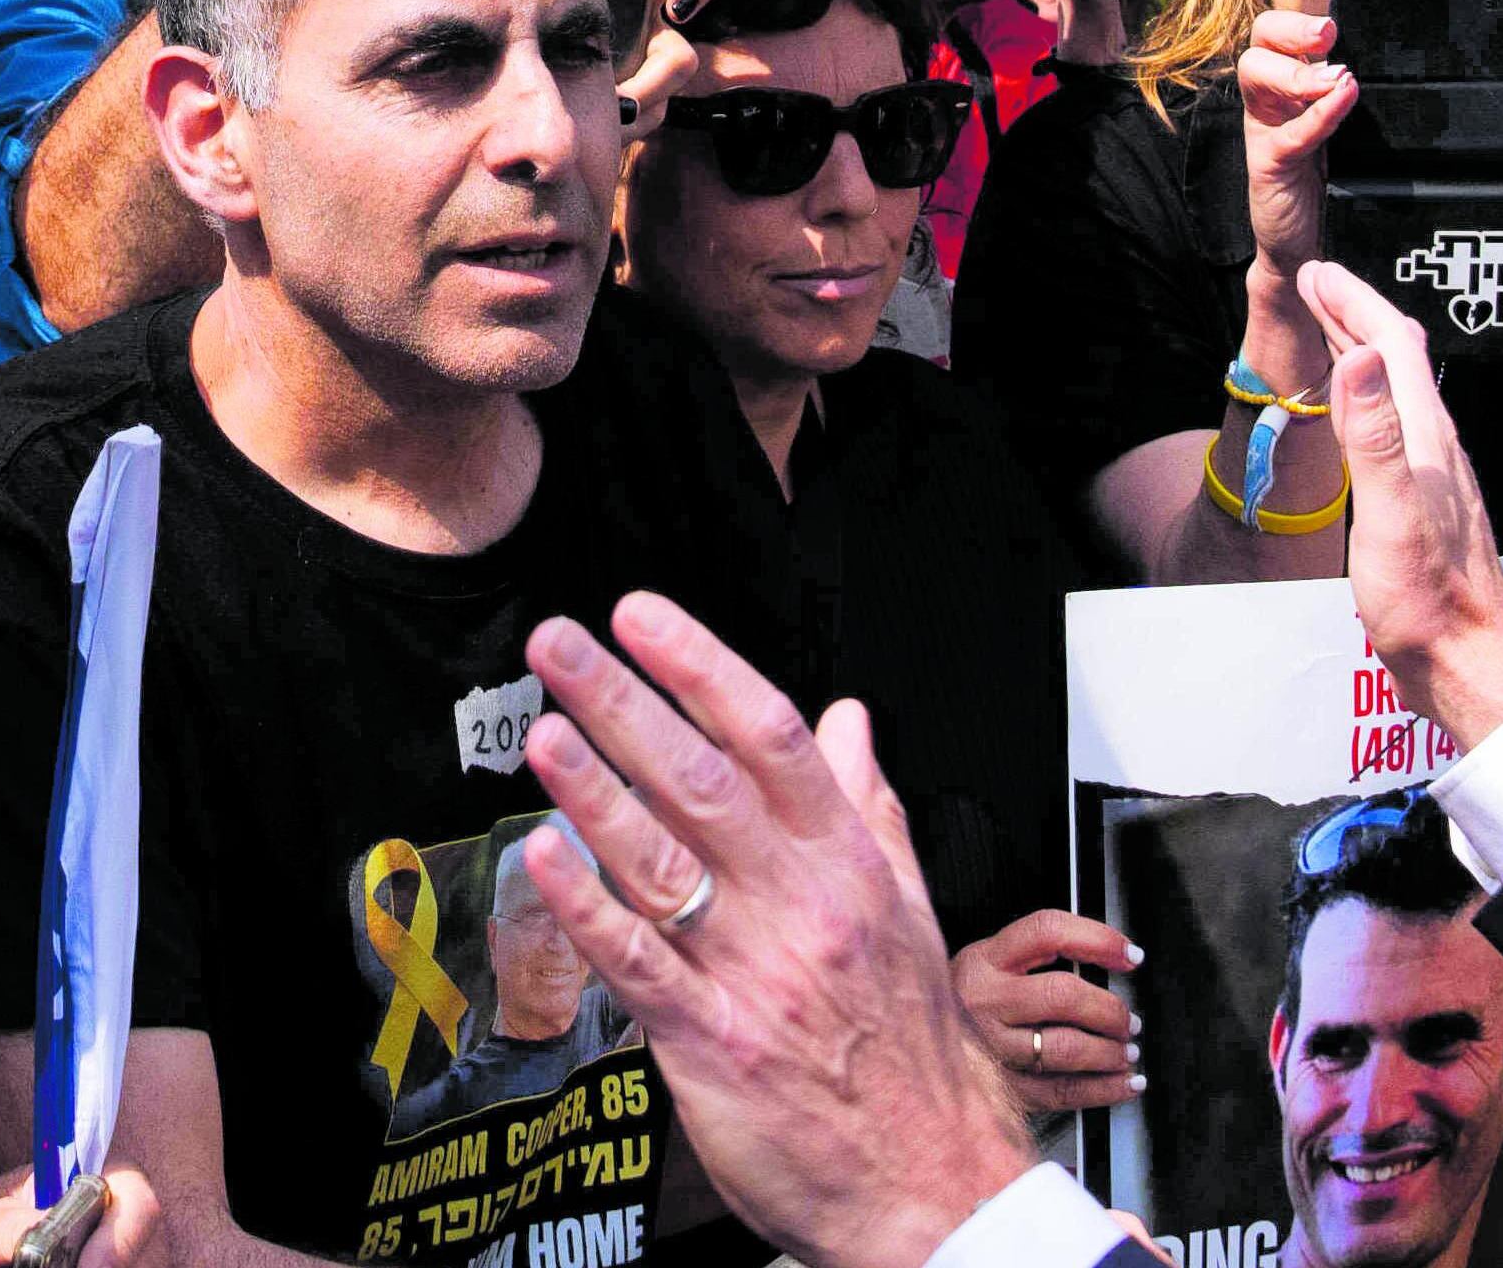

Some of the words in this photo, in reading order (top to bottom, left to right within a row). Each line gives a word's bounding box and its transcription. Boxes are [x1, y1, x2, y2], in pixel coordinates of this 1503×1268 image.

[367, 1130, 488, 1207] AMIRAM
[506, 1086, 593, 1167] COOPER,
[601, 1069, 649, 1121] 85
[516, 1135, 650, 1210] עמירם
[356, 1215, 404, 1262] 85
[528, 1204, 644, 1268] HOME
